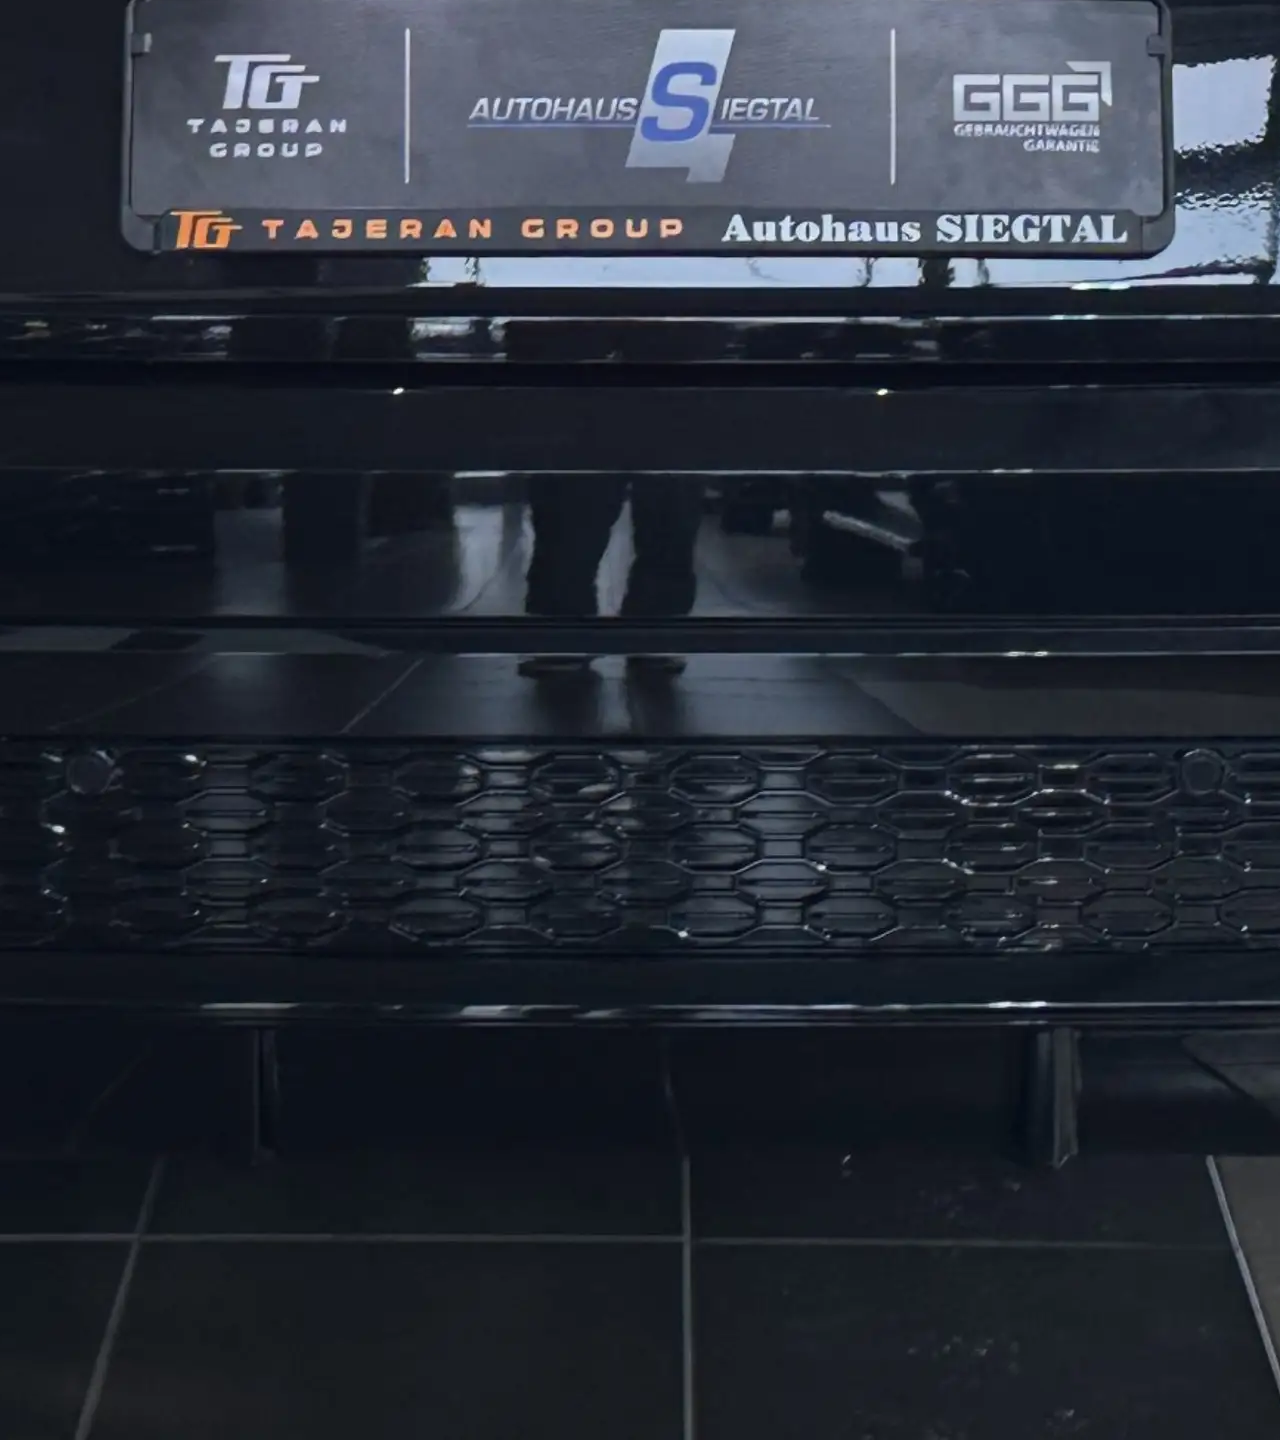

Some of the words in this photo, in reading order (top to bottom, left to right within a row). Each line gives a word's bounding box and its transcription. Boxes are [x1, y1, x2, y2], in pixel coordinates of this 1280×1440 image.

[214, 54, 320, 109] TG
[468, 97, 638, 121] AUTOHAUS
[953, 74, 1100, 122] GGG
[186, 118, 347, 134] TAJERAN
[209, 142, 323, 158] GROUP
[1023, 139, 1100, 153] GARANTIE
[170, 211, 243, 249] TG
[262, 218, 492, 240] TAJERAN
[521, 218, 683, 239] GROUP
[721, 213, 921, 243] Autohaus
[936, 214, 1128, 243] SIEGTAL
